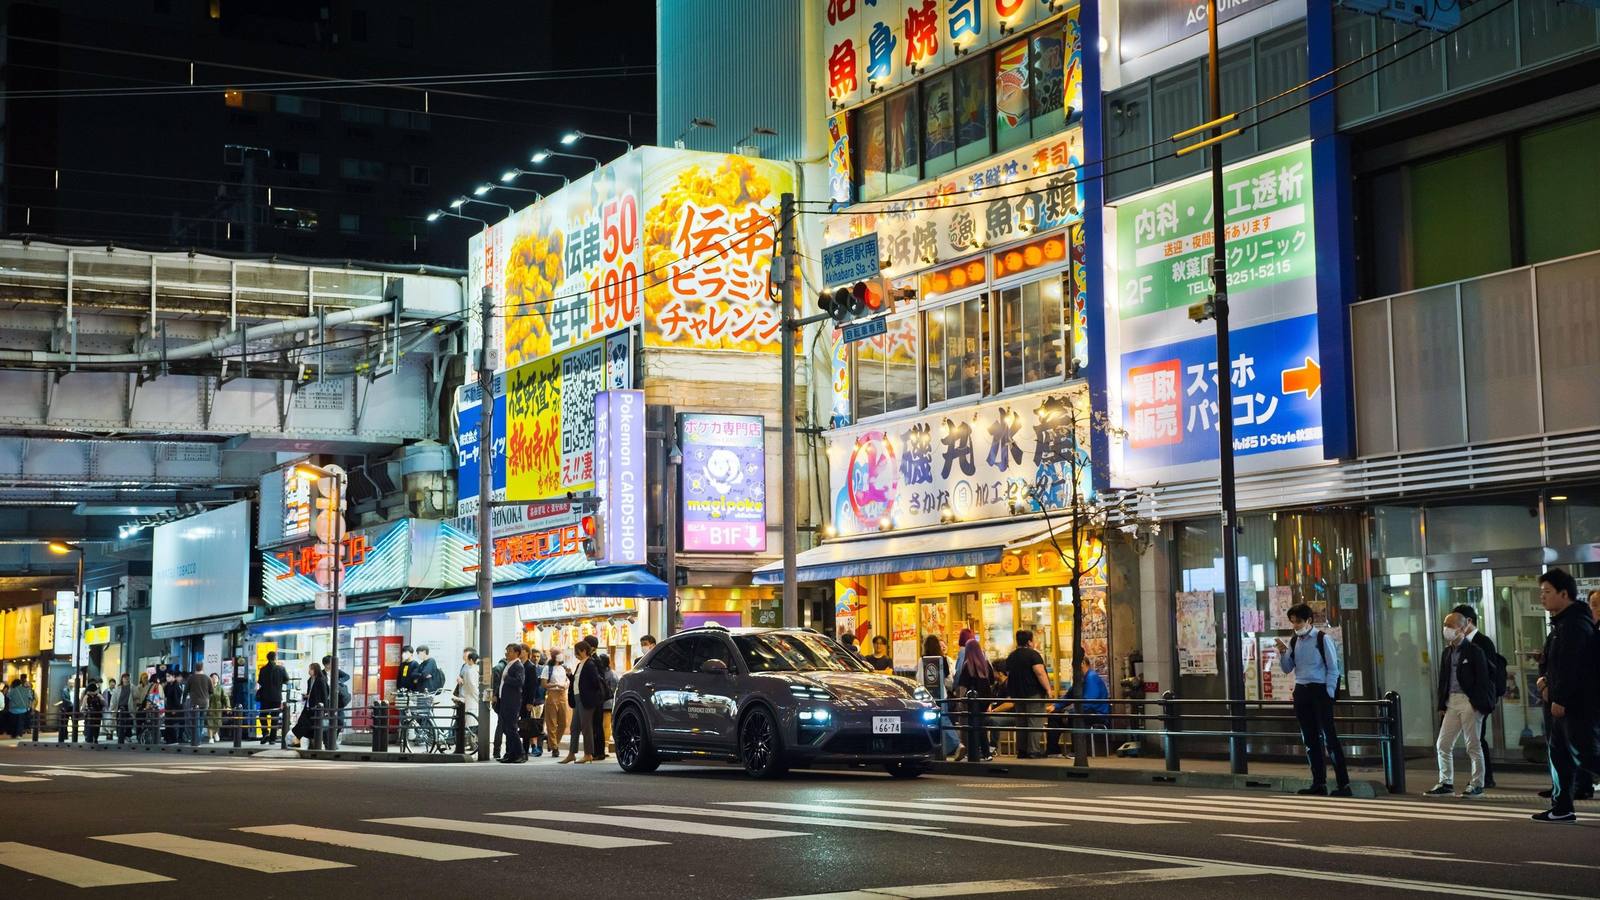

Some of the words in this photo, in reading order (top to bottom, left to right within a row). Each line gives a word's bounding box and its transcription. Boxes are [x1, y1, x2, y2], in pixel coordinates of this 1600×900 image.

[676, 204, 775, 265] 伝串
[824, 239, 876, 270] 秋葉原駅南
[1133, 370, 1176, 407] 買取
[620, 393, 634, 466] Pokemon
[684, 420, 762, 437] ポケカ専門店
[1133, 404, 1178, 440] 販売
[509, 415, 560, 477] 新時代
[620, 472, 635, 561] CARDSHOP
[710, 527, 741, 545] B1F
[878, 723, 900, 733] 66-74
